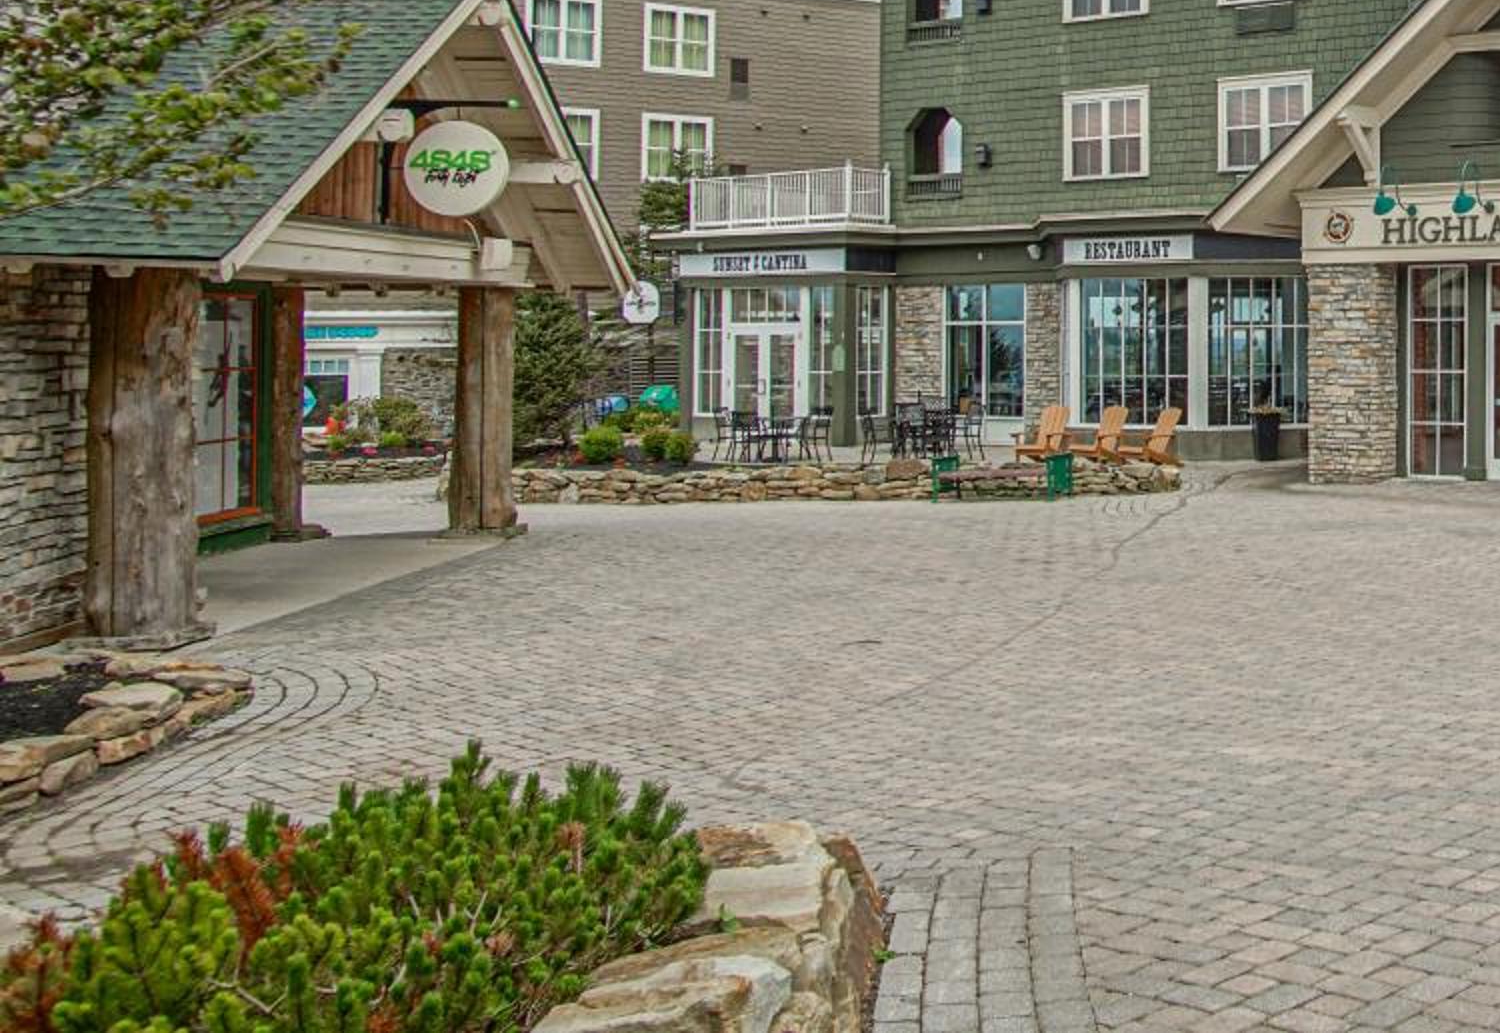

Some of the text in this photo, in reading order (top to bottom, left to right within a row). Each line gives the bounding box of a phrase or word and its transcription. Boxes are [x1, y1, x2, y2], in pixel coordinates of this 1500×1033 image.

[409, 149, 490, 174] 4848
[1084, 240, 1171, 260] RESTAURANT
[761, 253, 807, 271] CANTINA
